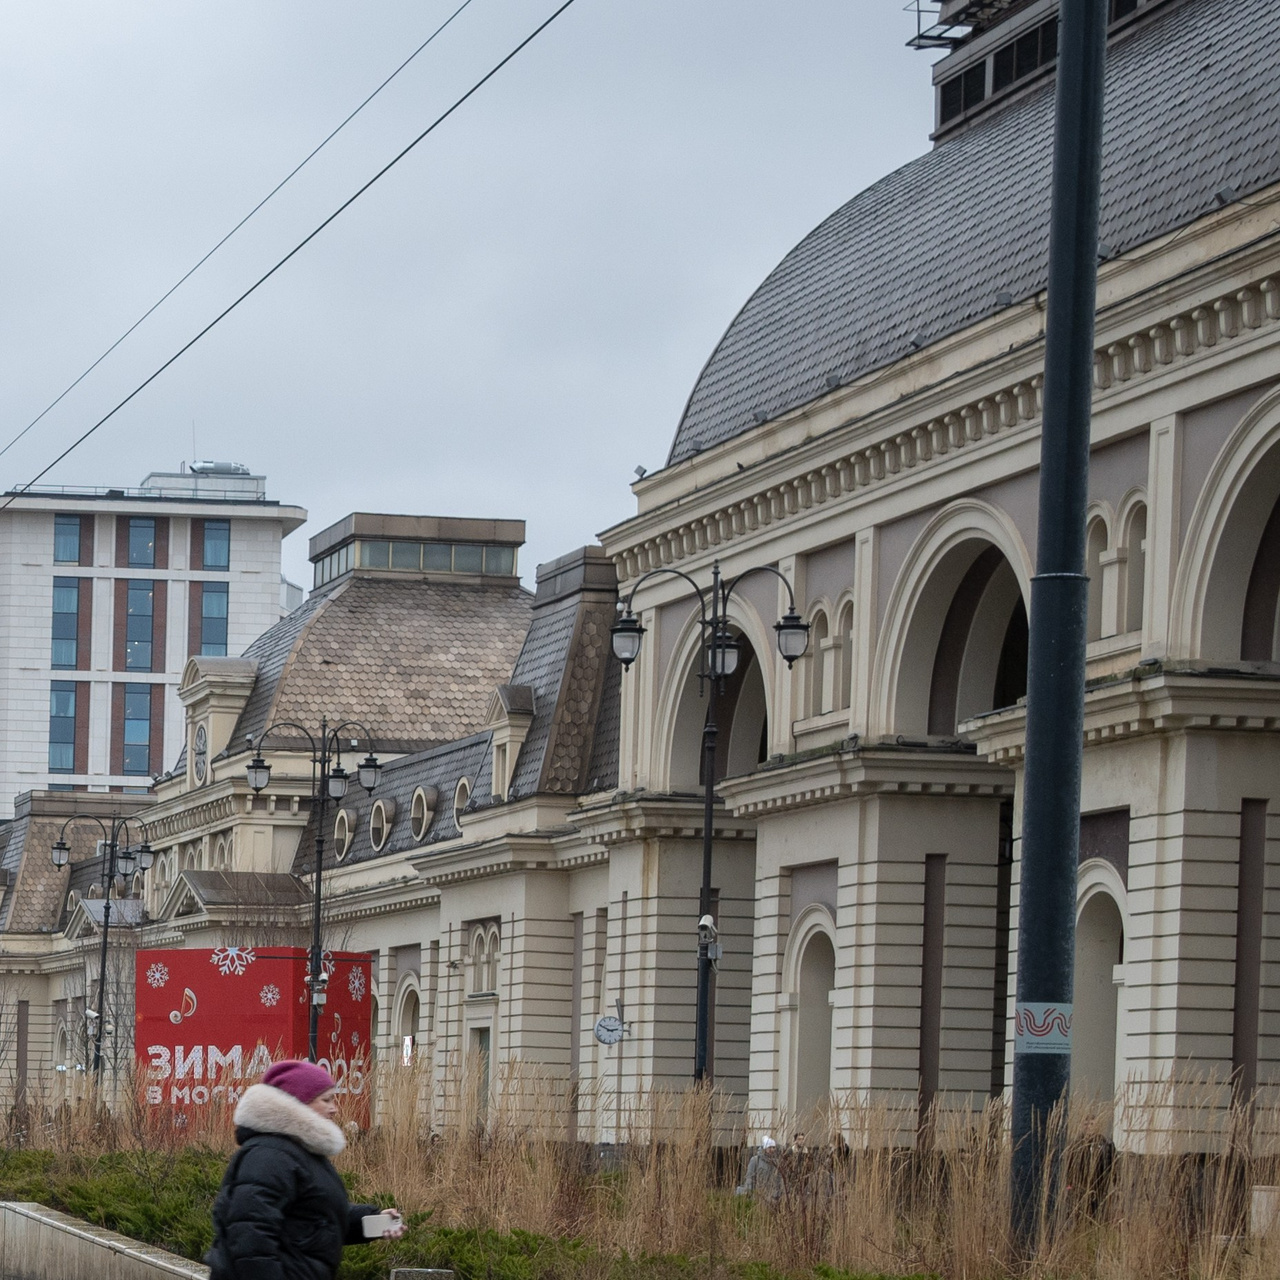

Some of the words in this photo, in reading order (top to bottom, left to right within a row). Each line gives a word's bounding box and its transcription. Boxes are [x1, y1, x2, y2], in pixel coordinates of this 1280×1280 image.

[147, 1045, 271, 1079] ЗИМА
[147, 1085, 162, 1104] В
[170, 1085, 249, 1104] МОСК
